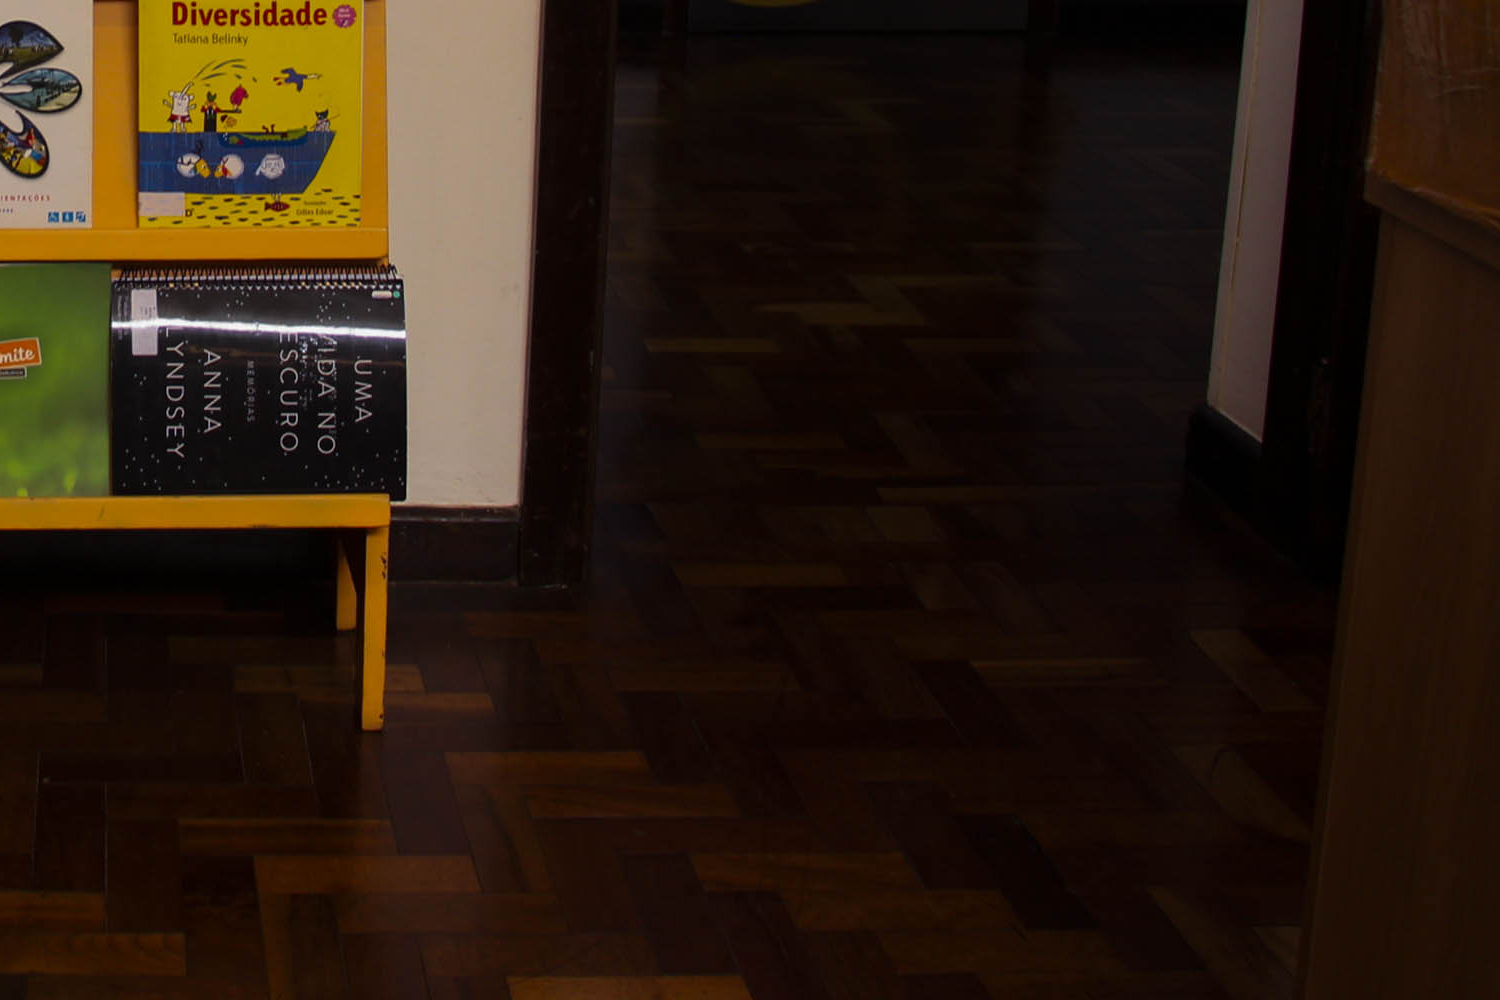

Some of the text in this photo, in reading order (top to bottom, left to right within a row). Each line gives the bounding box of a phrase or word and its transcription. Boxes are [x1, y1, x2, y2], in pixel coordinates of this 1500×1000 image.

[172, 0, 327, 28] Diversidade
[172, 32, 249, 48] Tatiana Belinky
[203, 348, 222, 434] ANNA
[246, 360, 256, 423] MEMÓRIAS
[279, 331, 299, 452] ESCURO
[317, 334, 337, 455] VIDA NO
[353, 358, 373, 424] UMA
